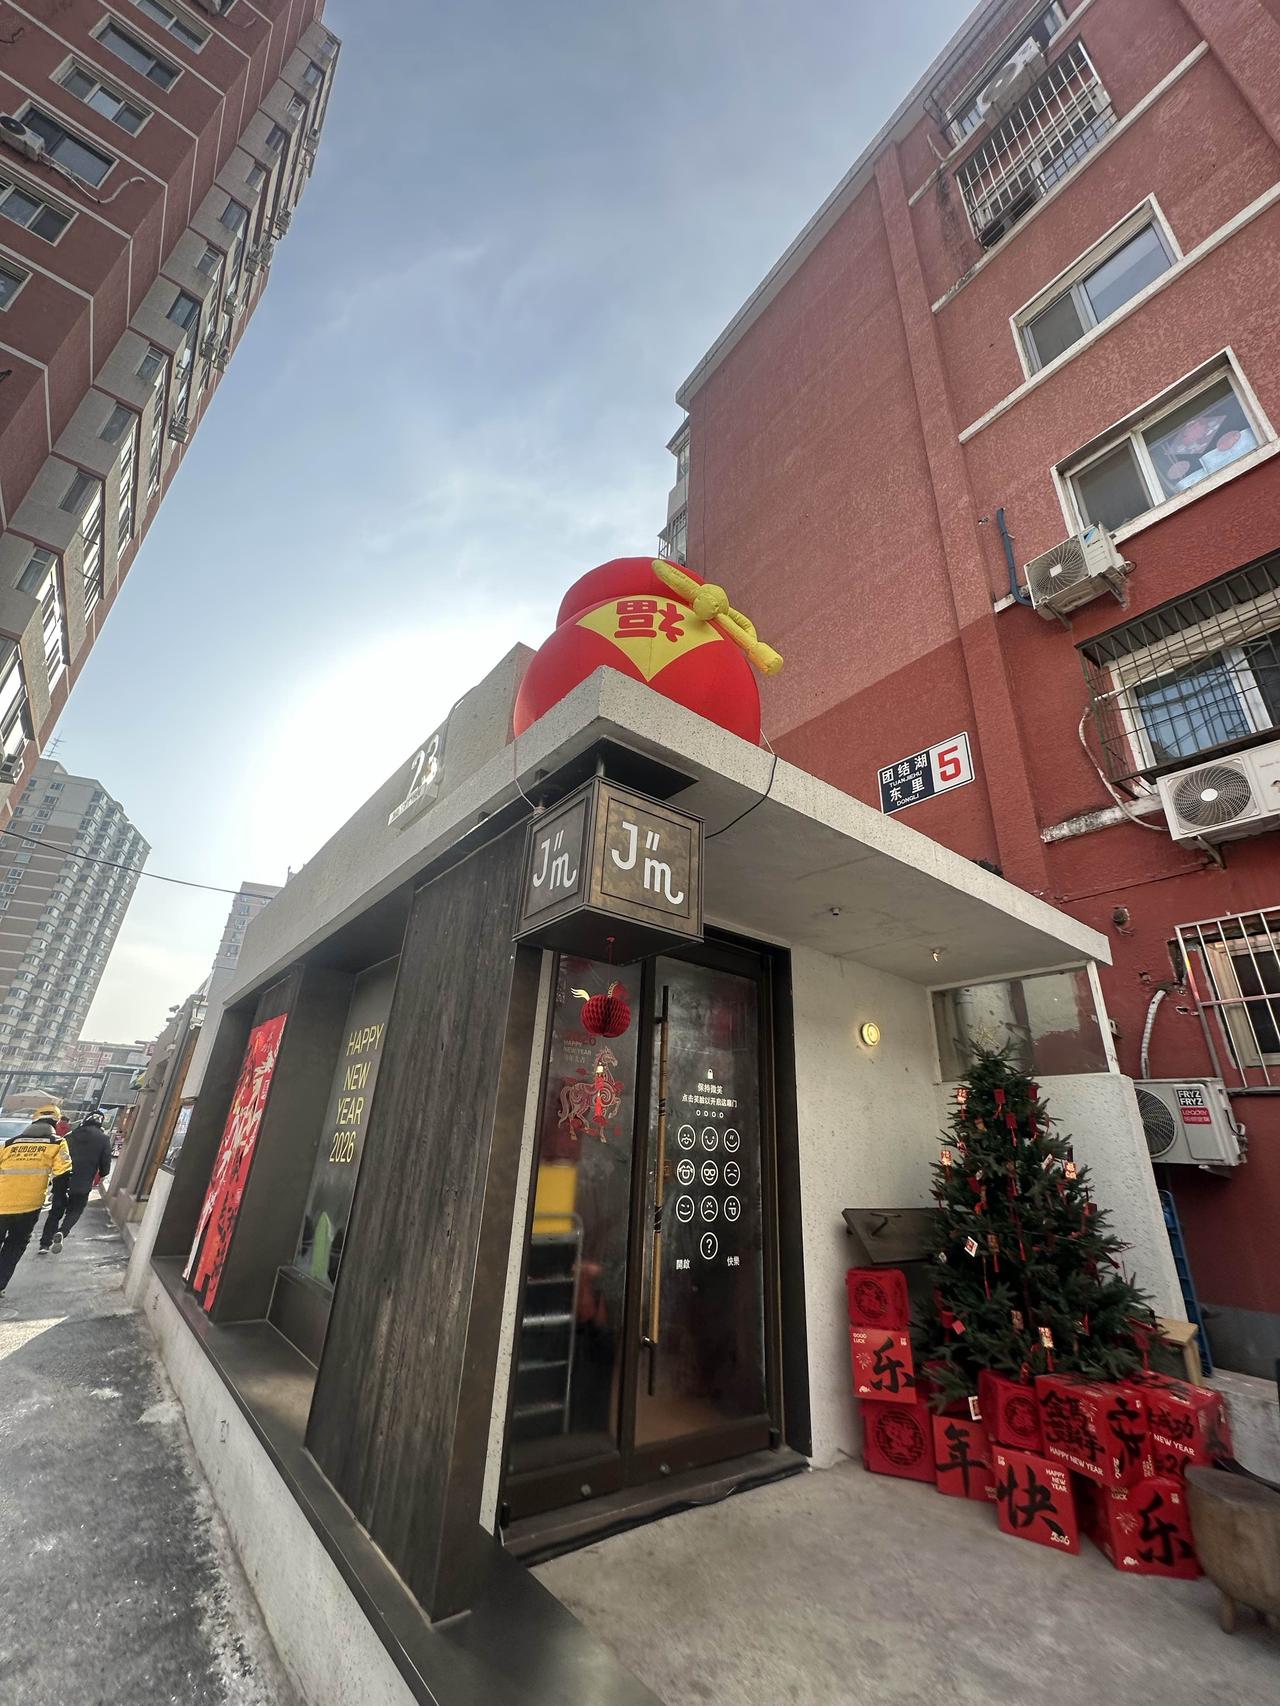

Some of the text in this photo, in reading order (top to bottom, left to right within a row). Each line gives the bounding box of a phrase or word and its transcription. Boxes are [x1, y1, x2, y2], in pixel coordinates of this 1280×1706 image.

[614, 599, 685, 643] 福
[882, 753, 928, 785] 团结湖
[937, 745, 962, 782] 5
[889, 770, 923, 788] TUANJIEHU
[889, 777, 925, 802] 东里
[346, 1022, 385, 1057] HAPPY
[343, 1061, 372, 1091] NEW
[697, 1082, 723, 1095] 保持微笑
[1178, 1090, 1201, 1098] FRYZ
[336, 1096, 365, 1125] YEAR
[329, 1131, 356, 1163] 2026
[870, 1335, 916, 1394] 乐
[1153, 1433, 1195, 1456] NEW YEAR
[935, 1422, 988, 1498] 年
[1045, 1468, 1065, 1479] HAPPY
[1049, 1445, 1104, 1477] HAPPY NEW YEAR
[1051, 1483, 1068, 1492] YEAR
[1052, 1477, 1066, 1485] NEW
[996, 1463, 1065, 1537] 快
